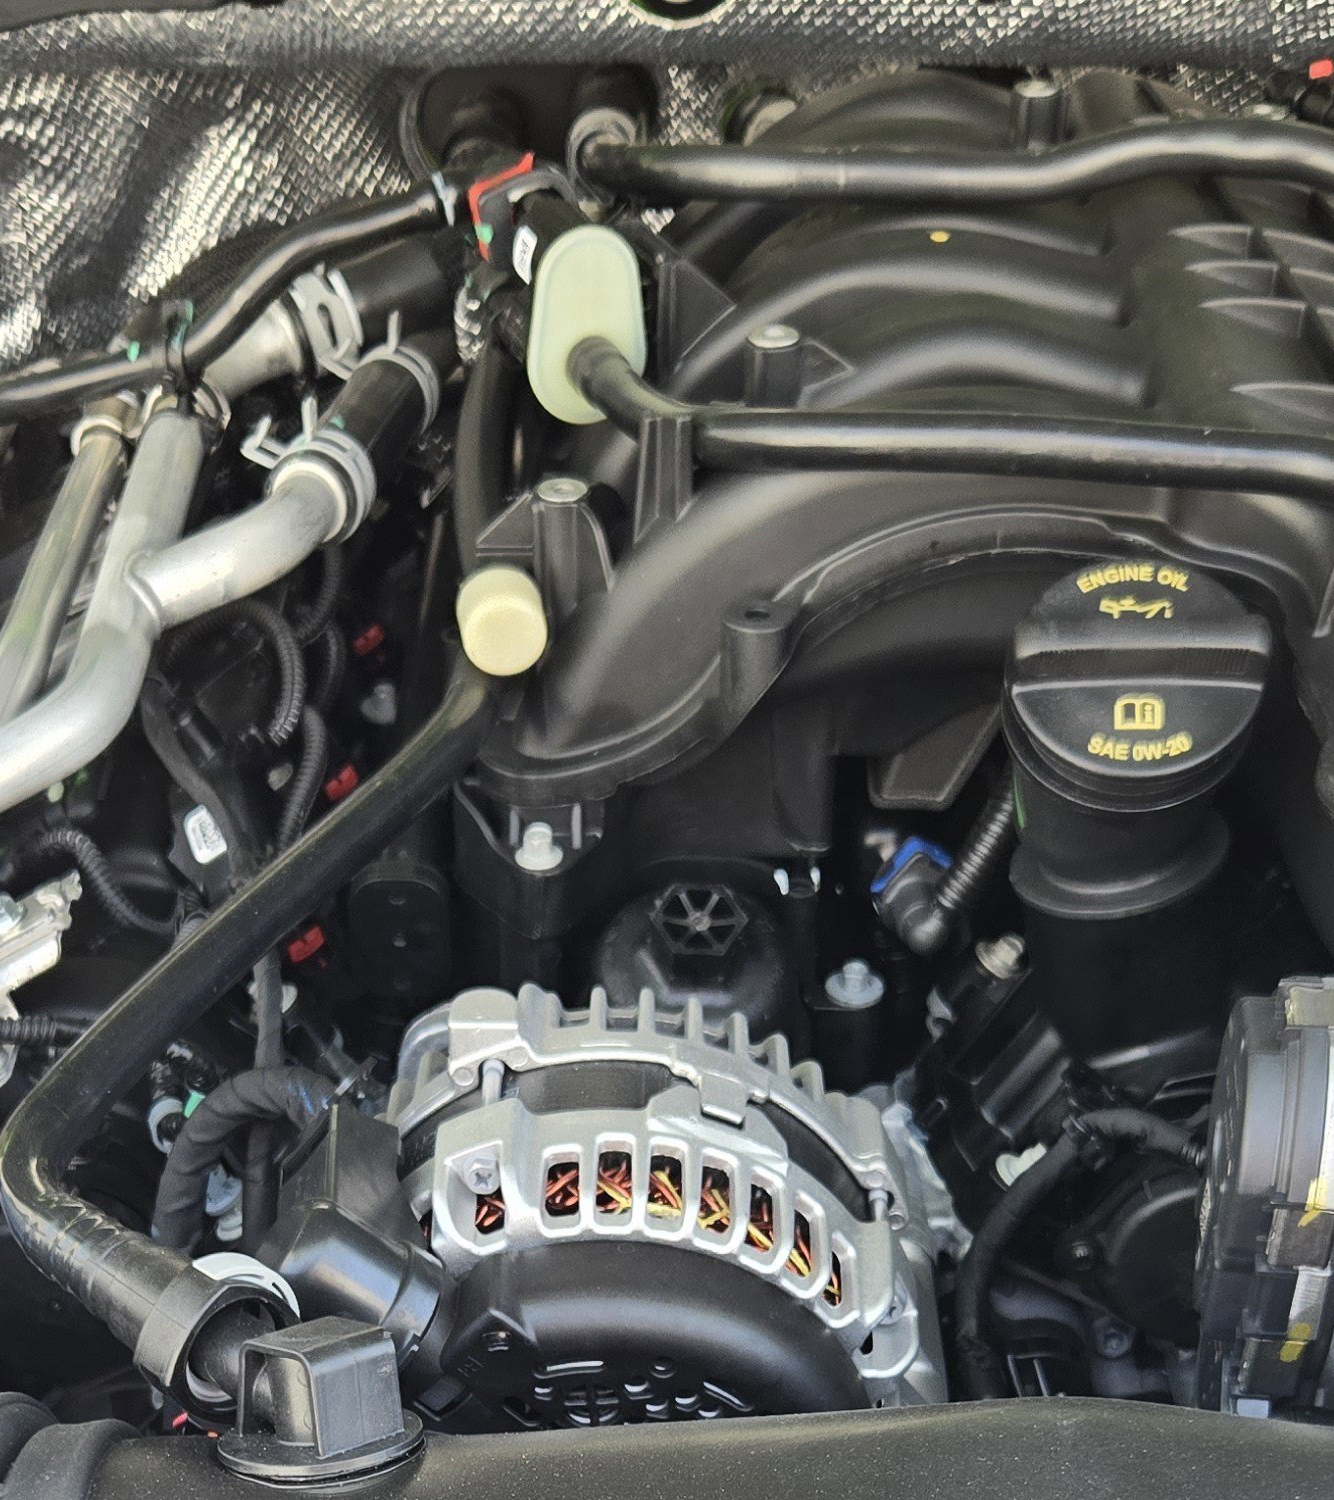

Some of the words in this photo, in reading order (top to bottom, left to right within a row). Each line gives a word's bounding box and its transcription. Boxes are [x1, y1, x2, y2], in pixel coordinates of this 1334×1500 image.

[1076, 563, 1154, 593] ENGINE
[1156, 566, 1191, 592] OIL
[1087, 732, 1129, 760] SAE
[1132, 731, 1194, 761] 0W-20
